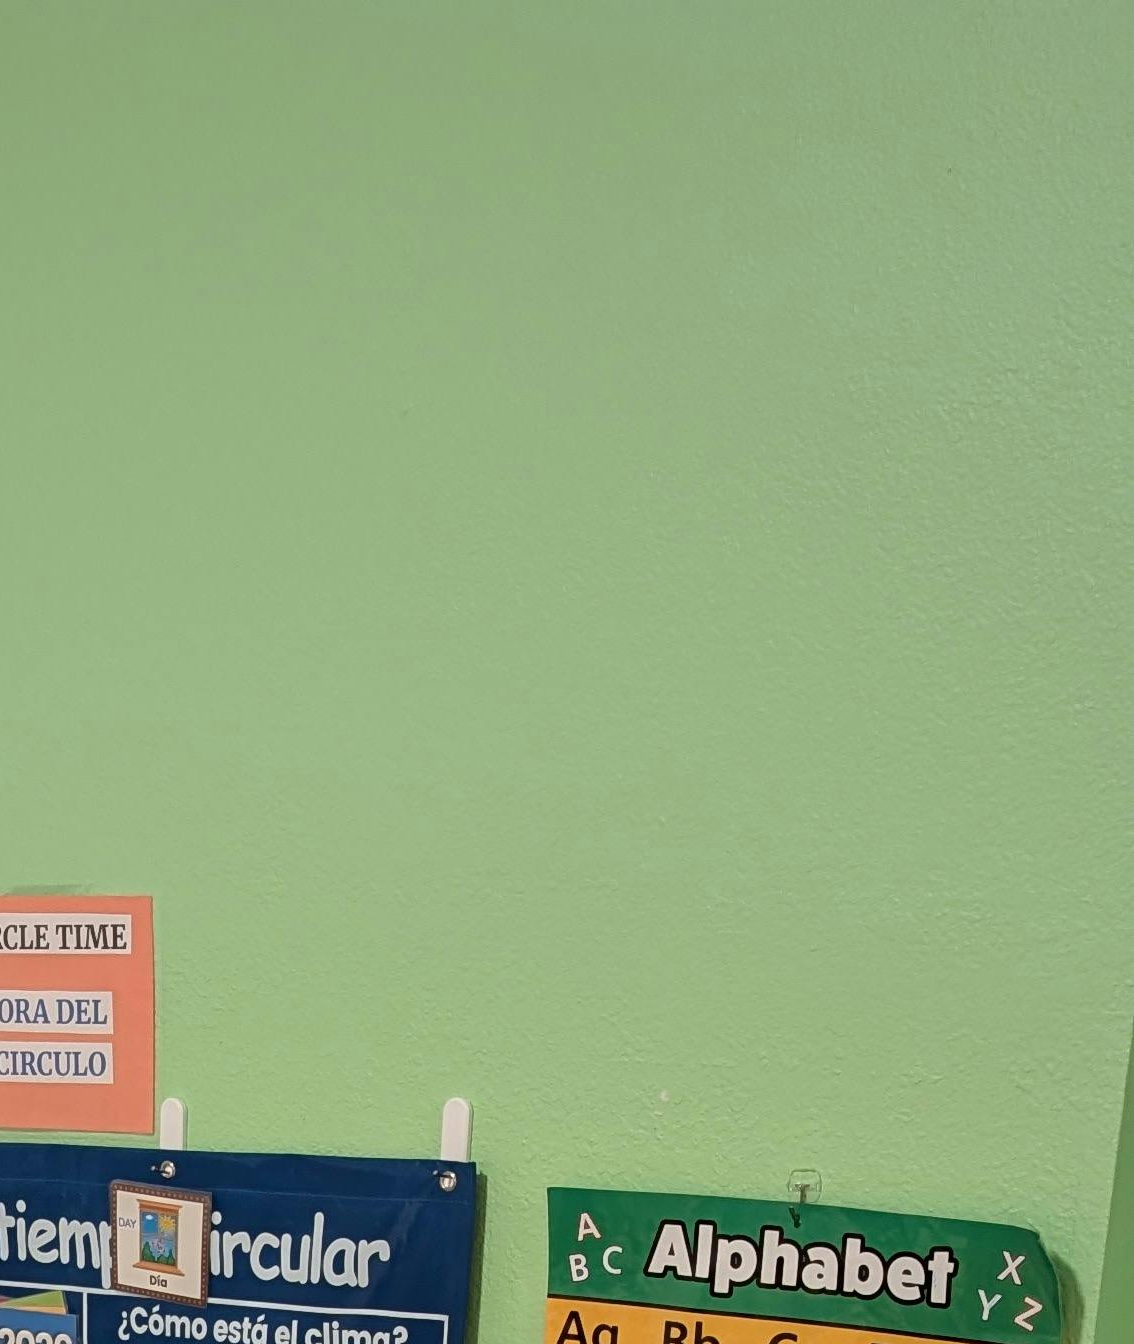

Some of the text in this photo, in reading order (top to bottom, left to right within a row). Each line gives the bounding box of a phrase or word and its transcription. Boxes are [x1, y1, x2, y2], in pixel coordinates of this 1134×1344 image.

[56, 924, 127, 950] TIME
[56, 998, 107, 1025] DEL
[118, 1217, 137, 1230] DAY
[577, 1212, 602, 1242] A
[210, 1211, 390, 1288] ircular
[569, 1246, 623, 1282] B C
[646, 1223, 955, 1304] Alphabet
[149, 1273, 167, 1288] Día
[997, 1251, 1026, 1285] X
[118, 1304, 208, 1341] ¿Cómo
[977, 1289, 1043, 1332] Y Z
